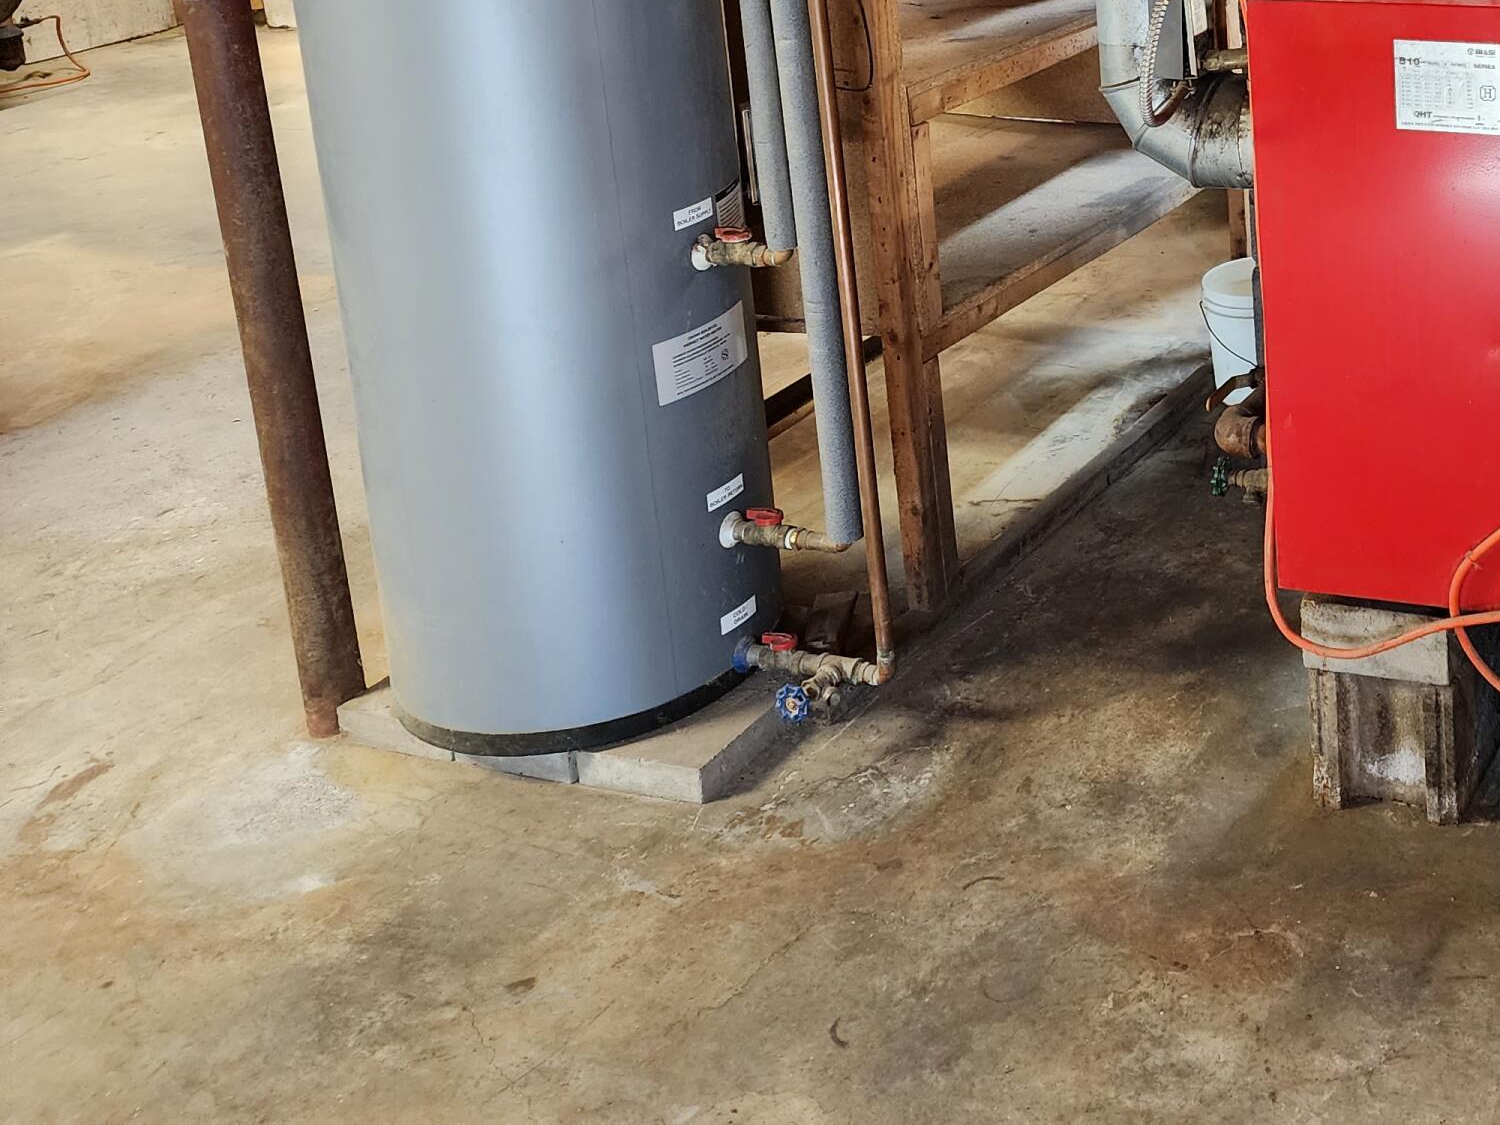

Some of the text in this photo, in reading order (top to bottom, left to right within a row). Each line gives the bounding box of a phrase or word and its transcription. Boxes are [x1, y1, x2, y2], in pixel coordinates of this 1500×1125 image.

[1399, 57, 1420, 66] B10
[1413, 111, 1432, 119] QHT
[677, 215, 696, 227] BOILER
